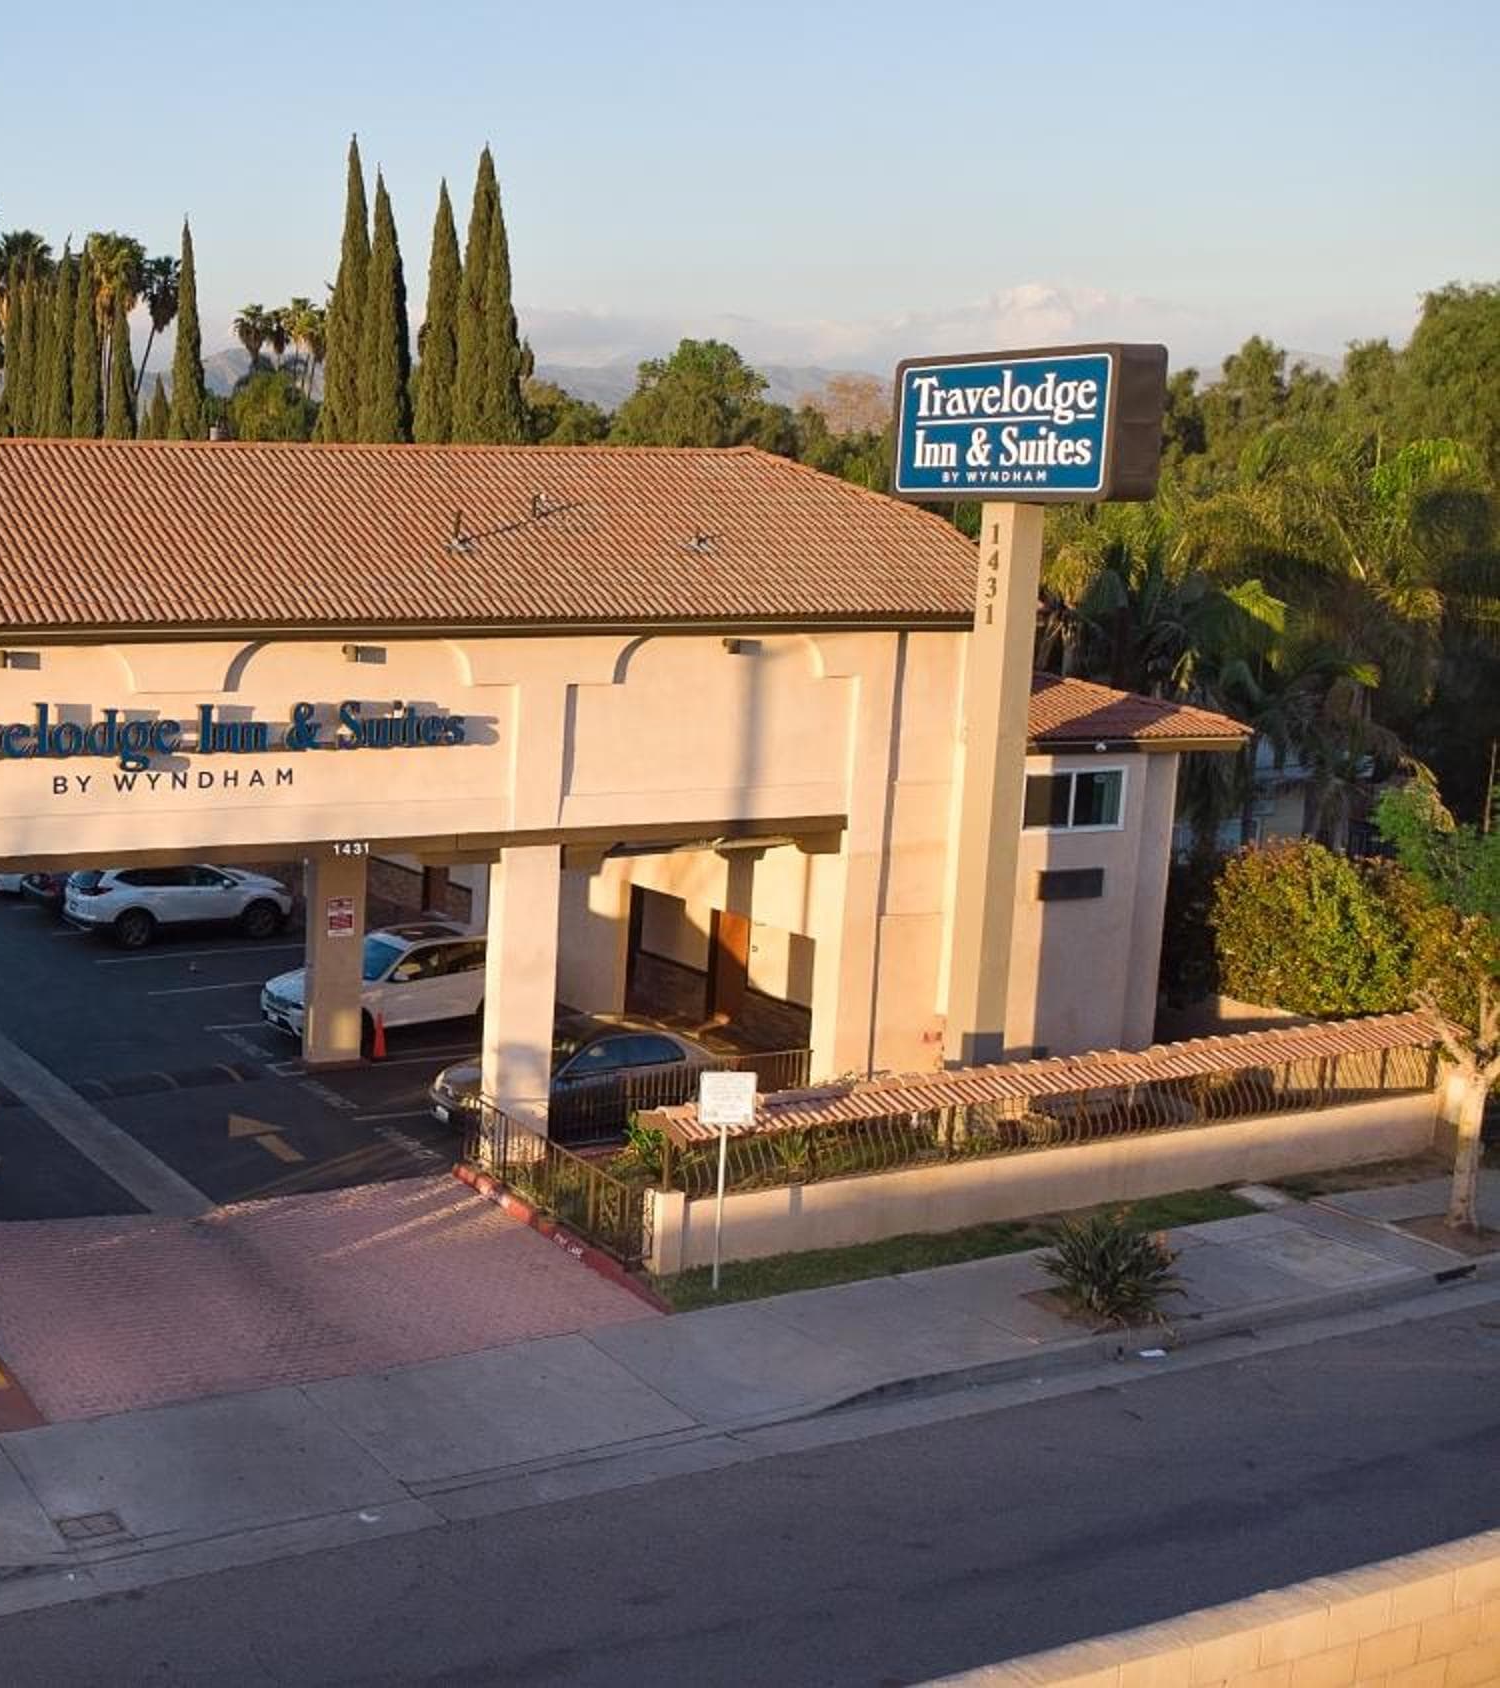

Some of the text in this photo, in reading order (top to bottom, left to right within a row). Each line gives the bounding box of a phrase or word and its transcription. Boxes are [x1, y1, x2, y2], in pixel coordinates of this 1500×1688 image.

[912, 369, 1098, 424] Travelodge
[912, 425, 1093, 468] Inn & Suites
[941, 470, 1048, 483] BY WYNDHAM
[984, 522, 1000, 625] 1431
[196, 703, 269, 753] Inn
[285, 701, 323, 751] &
[336, 700, 467, 751] Suites
[52, 767, 294, 795] BY WYNDHAM
[333, 841, 370, 856] 1431
